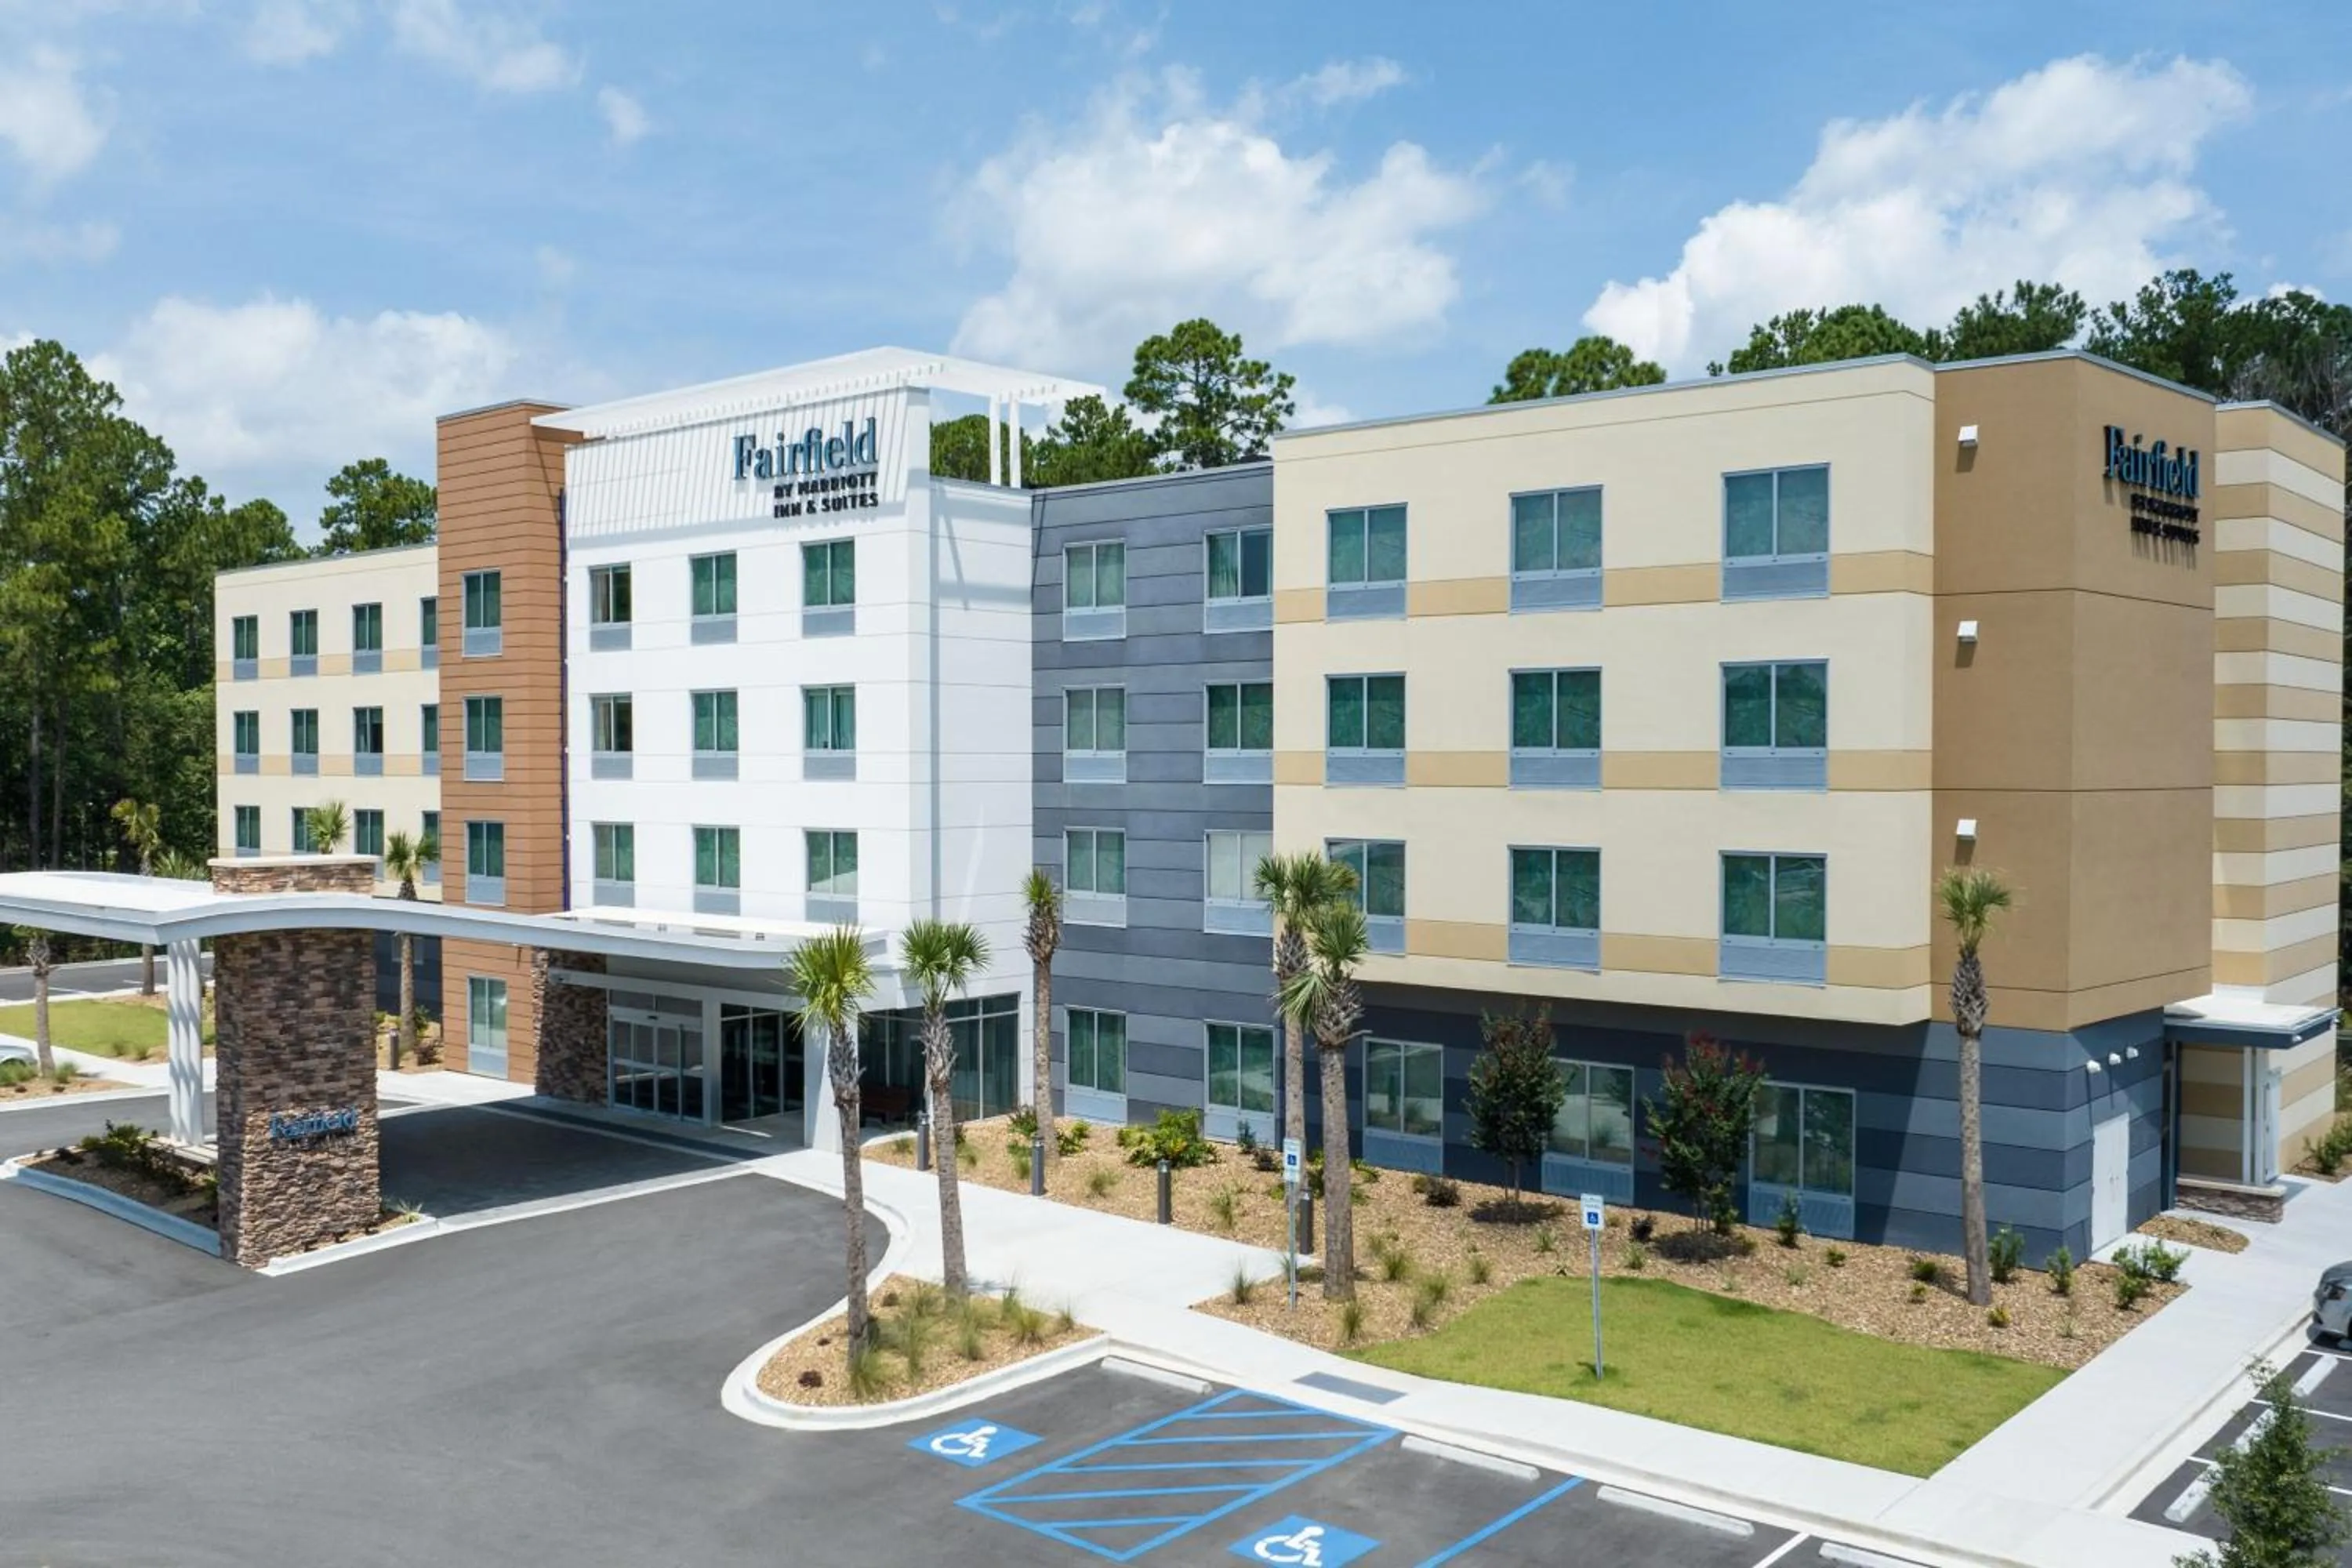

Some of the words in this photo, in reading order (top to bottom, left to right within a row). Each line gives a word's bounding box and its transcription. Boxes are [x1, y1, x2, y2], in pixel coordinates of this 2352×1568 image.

[733, 416, 878, 480] Fairfield
[2103, 425, 2200, 498] Fairfield
[774, 484, 793, 499] BY
[798, 472, 878, 495] MARRIOTT
[774, 502, 801, 518] INN
[806, 500, 817, 514] &
[822, 492, 879, 512] SUITES
